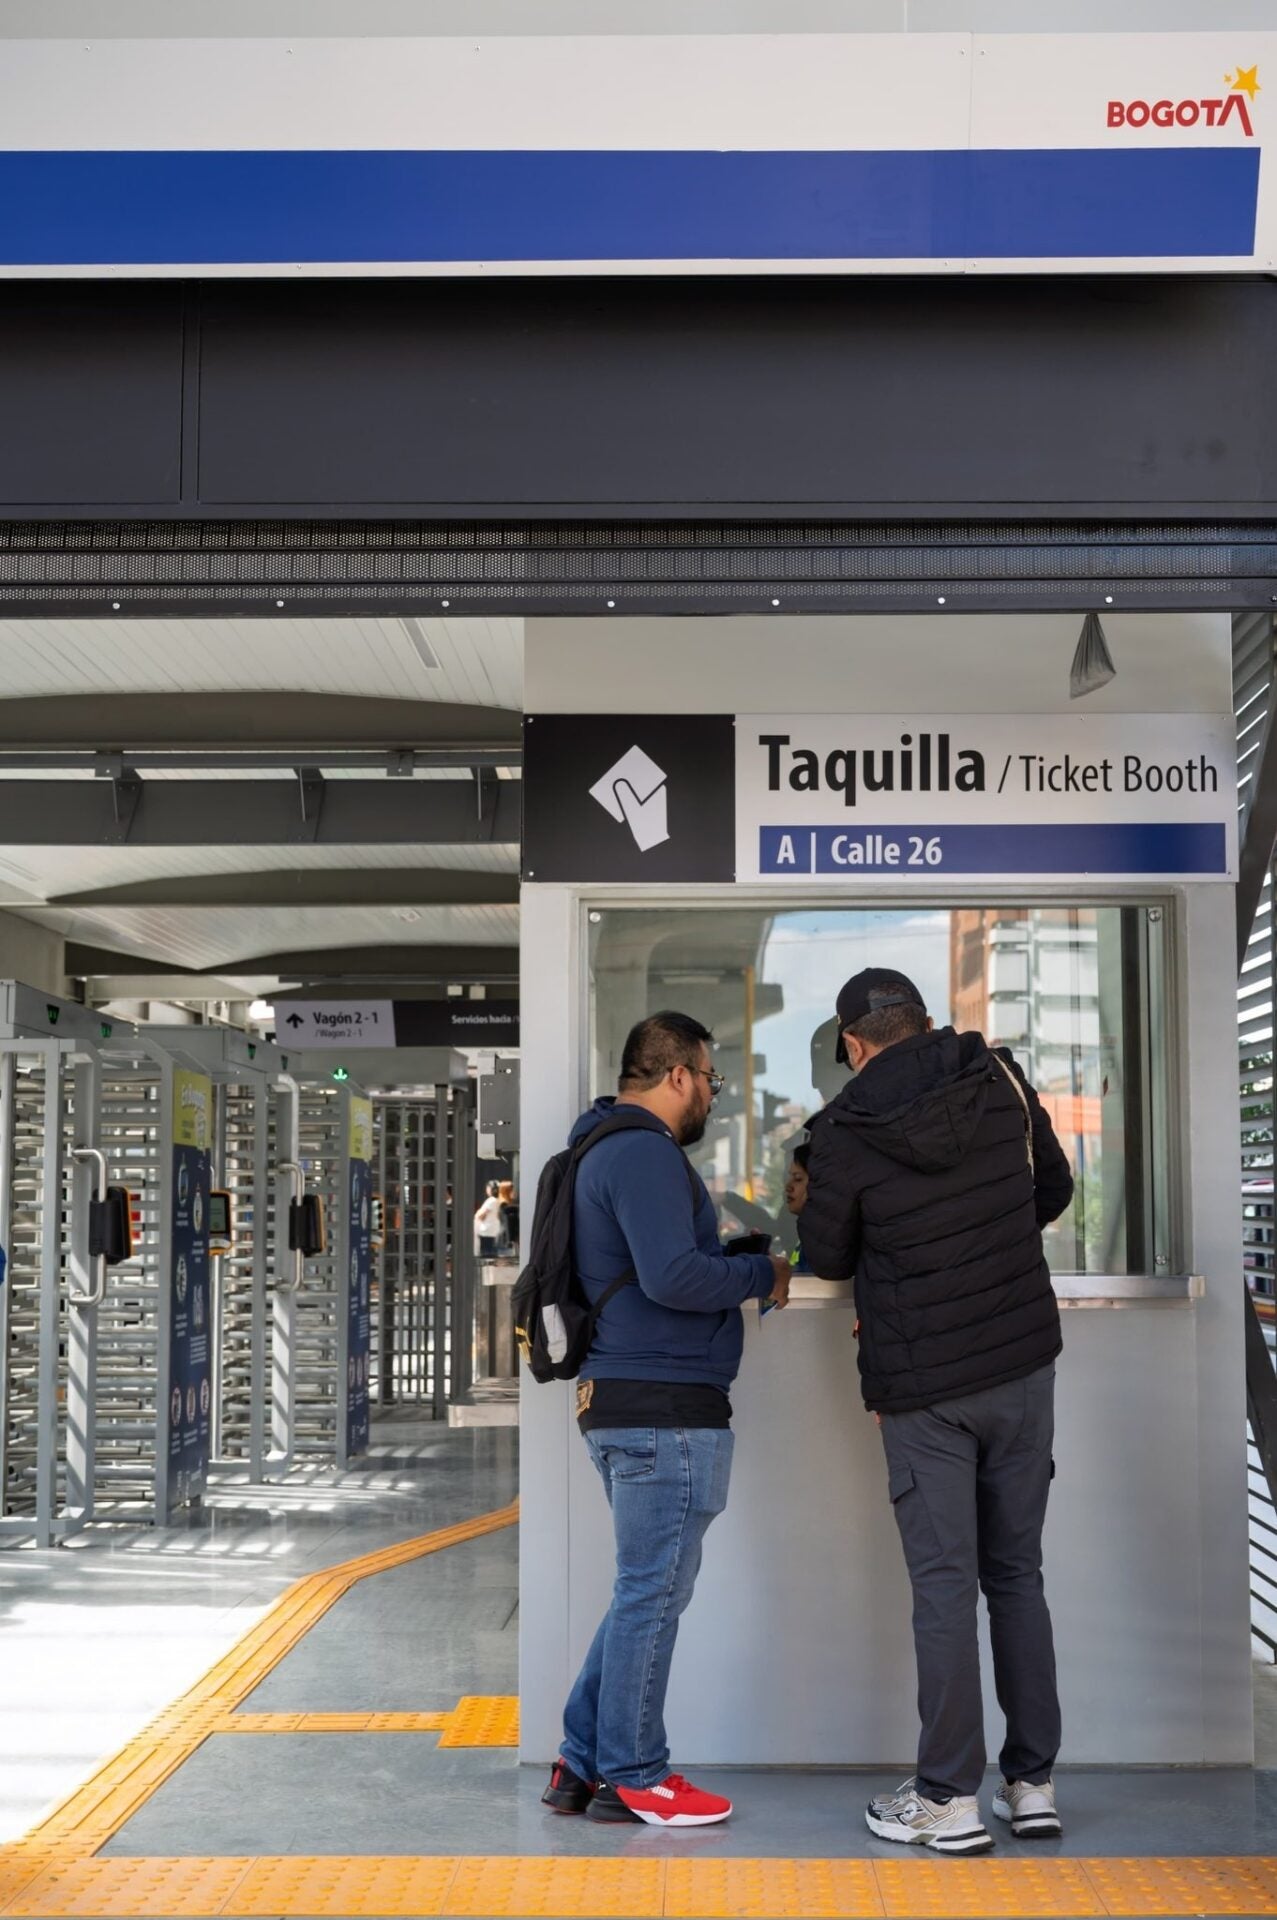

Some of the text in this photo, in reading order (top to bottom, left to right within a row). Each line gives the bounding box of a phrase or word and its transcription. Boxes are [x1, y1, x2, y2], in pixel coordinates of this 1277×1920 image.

[759, 733, 985, 806] Taquilla
[1019, 755, 1112, 792] Ticket
[1124, 755, 1218, 792] Booth
[776, 835, 943, 865] A Calle 26
[313, 1011, 352, 1027] Vagón
[354, 1012, 362, 1024] 2
[371, 1012, 379, 1024] 1
[451, 1014, 488, 1024] Servicios
[489, 1014, 511, 1024] hacia
